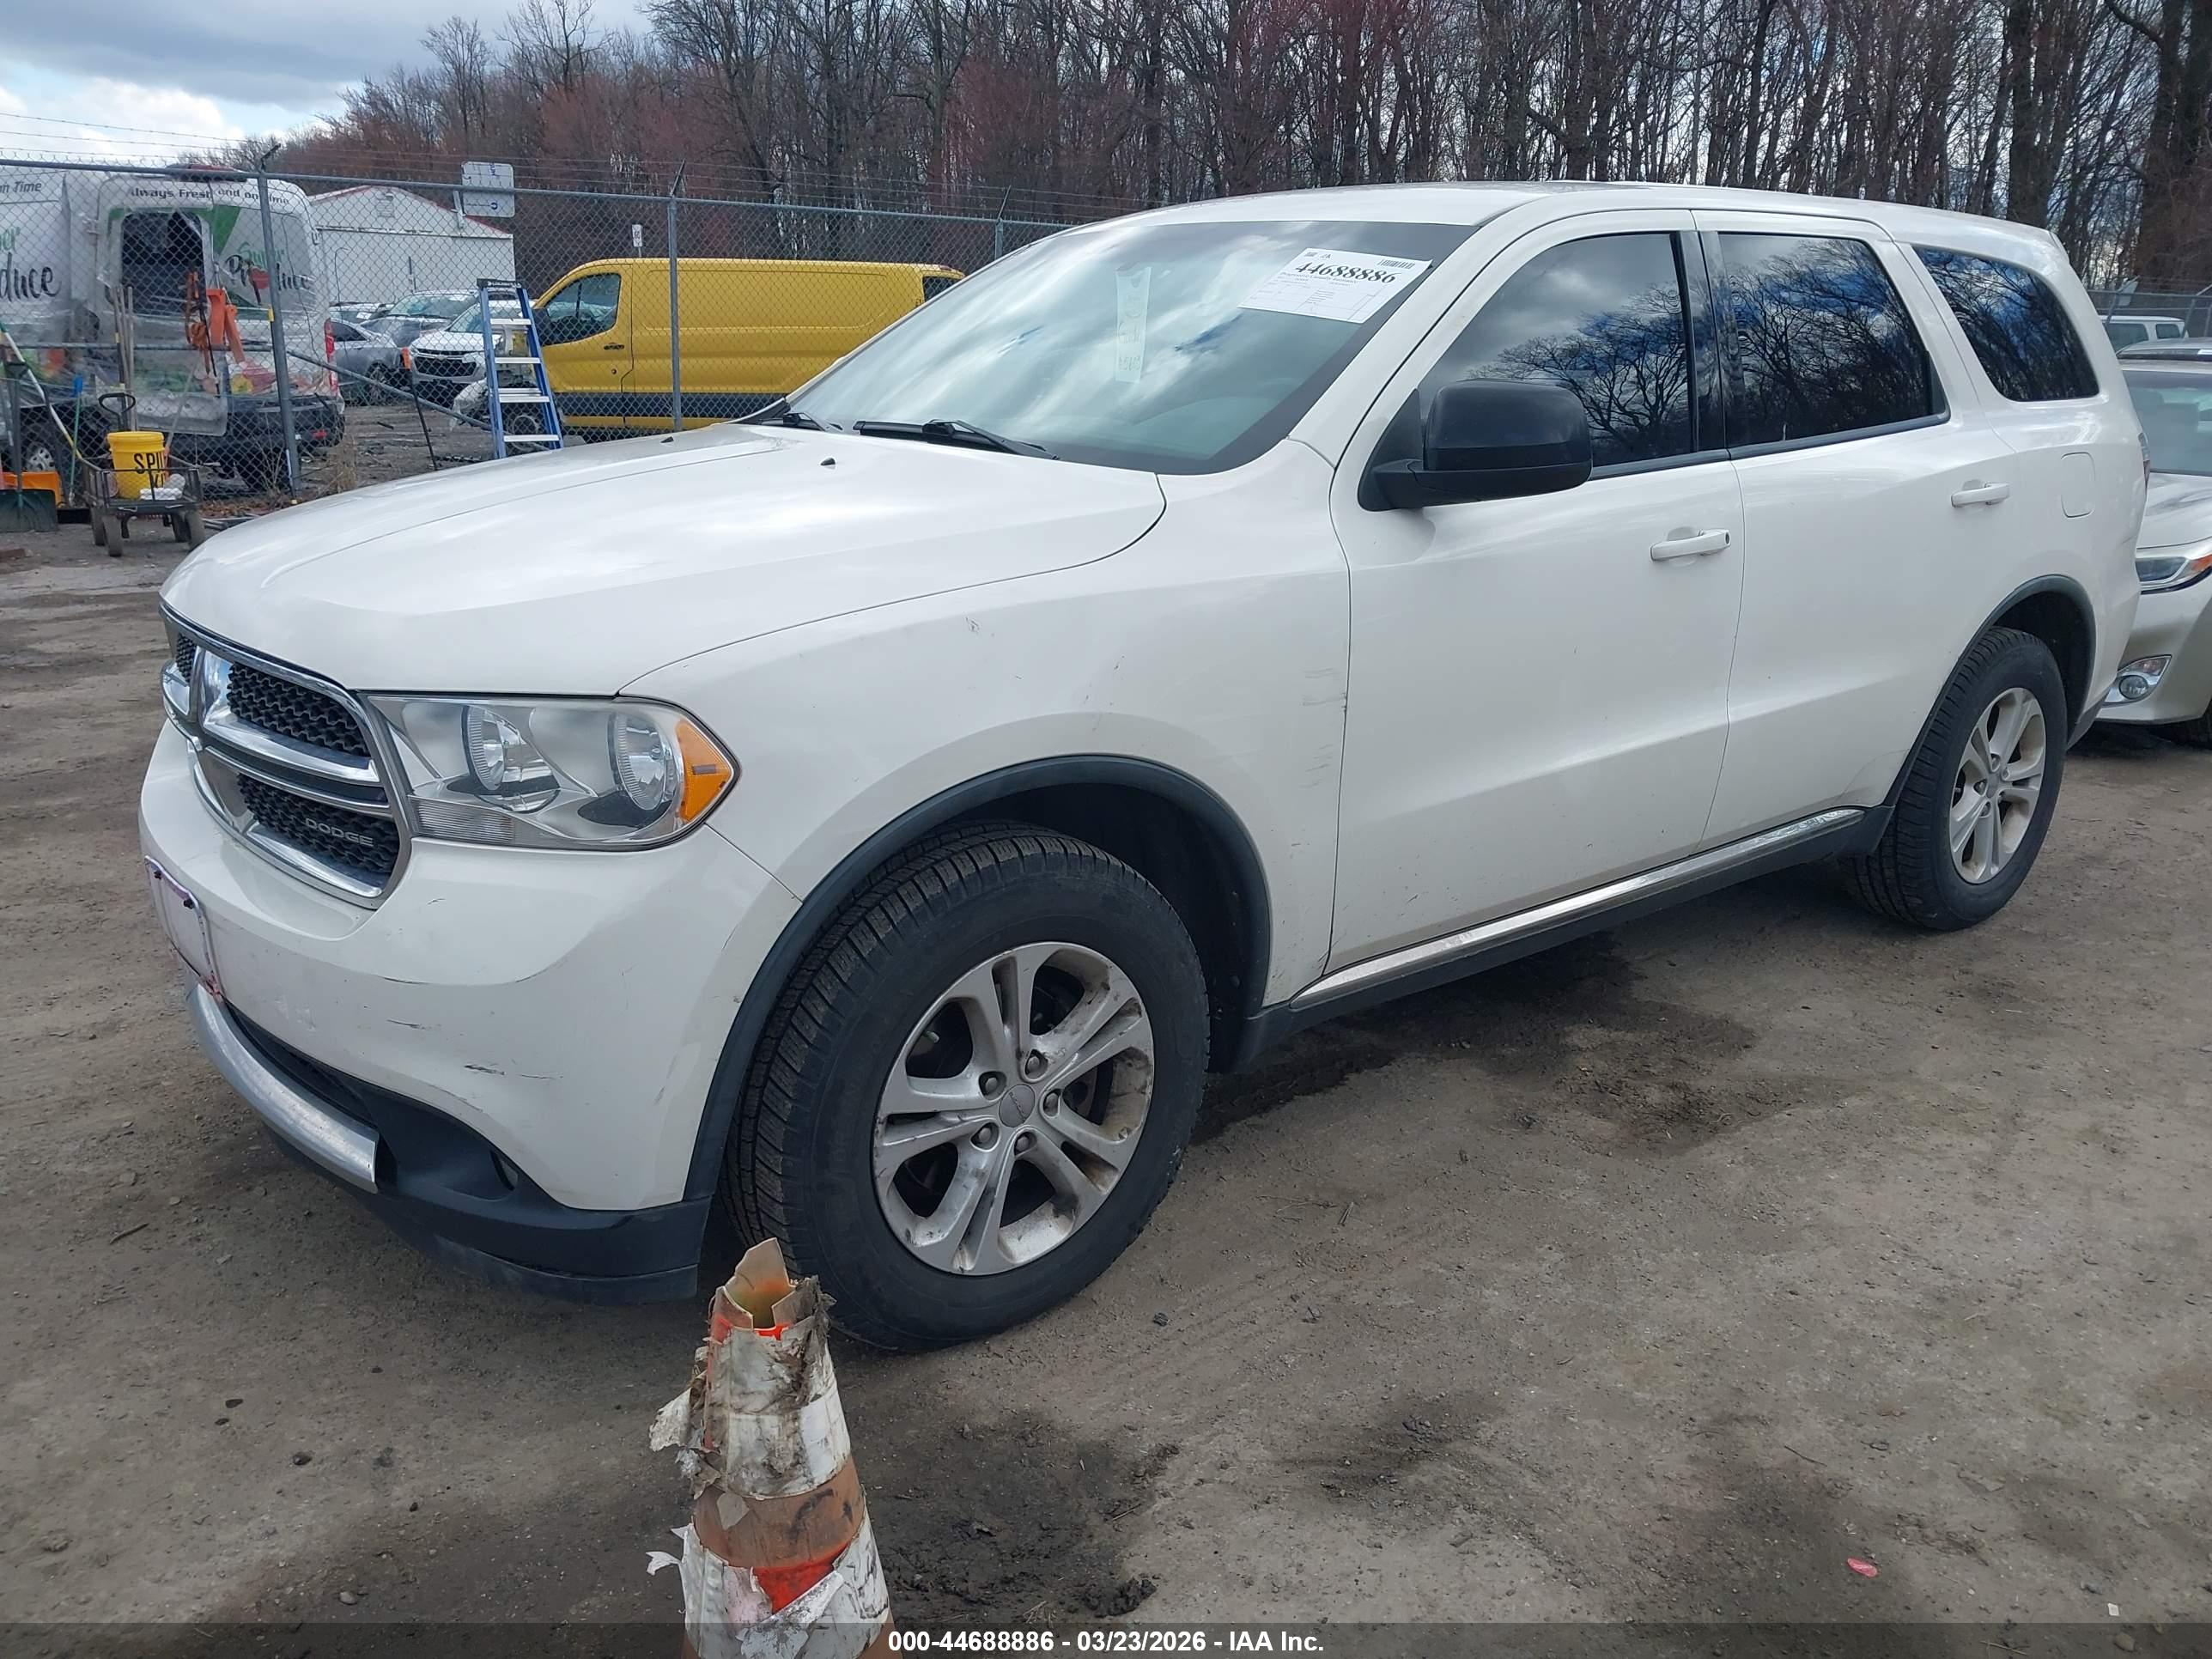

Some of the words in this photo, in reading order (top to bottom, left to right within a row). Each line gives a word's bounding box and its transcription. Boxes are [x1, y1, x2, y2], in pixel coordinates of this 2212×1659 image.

[13, 181, 42, 193] Time
[1295, 261, 1401, 284] 44688886
[305, 817, 374, 847] DODGE
